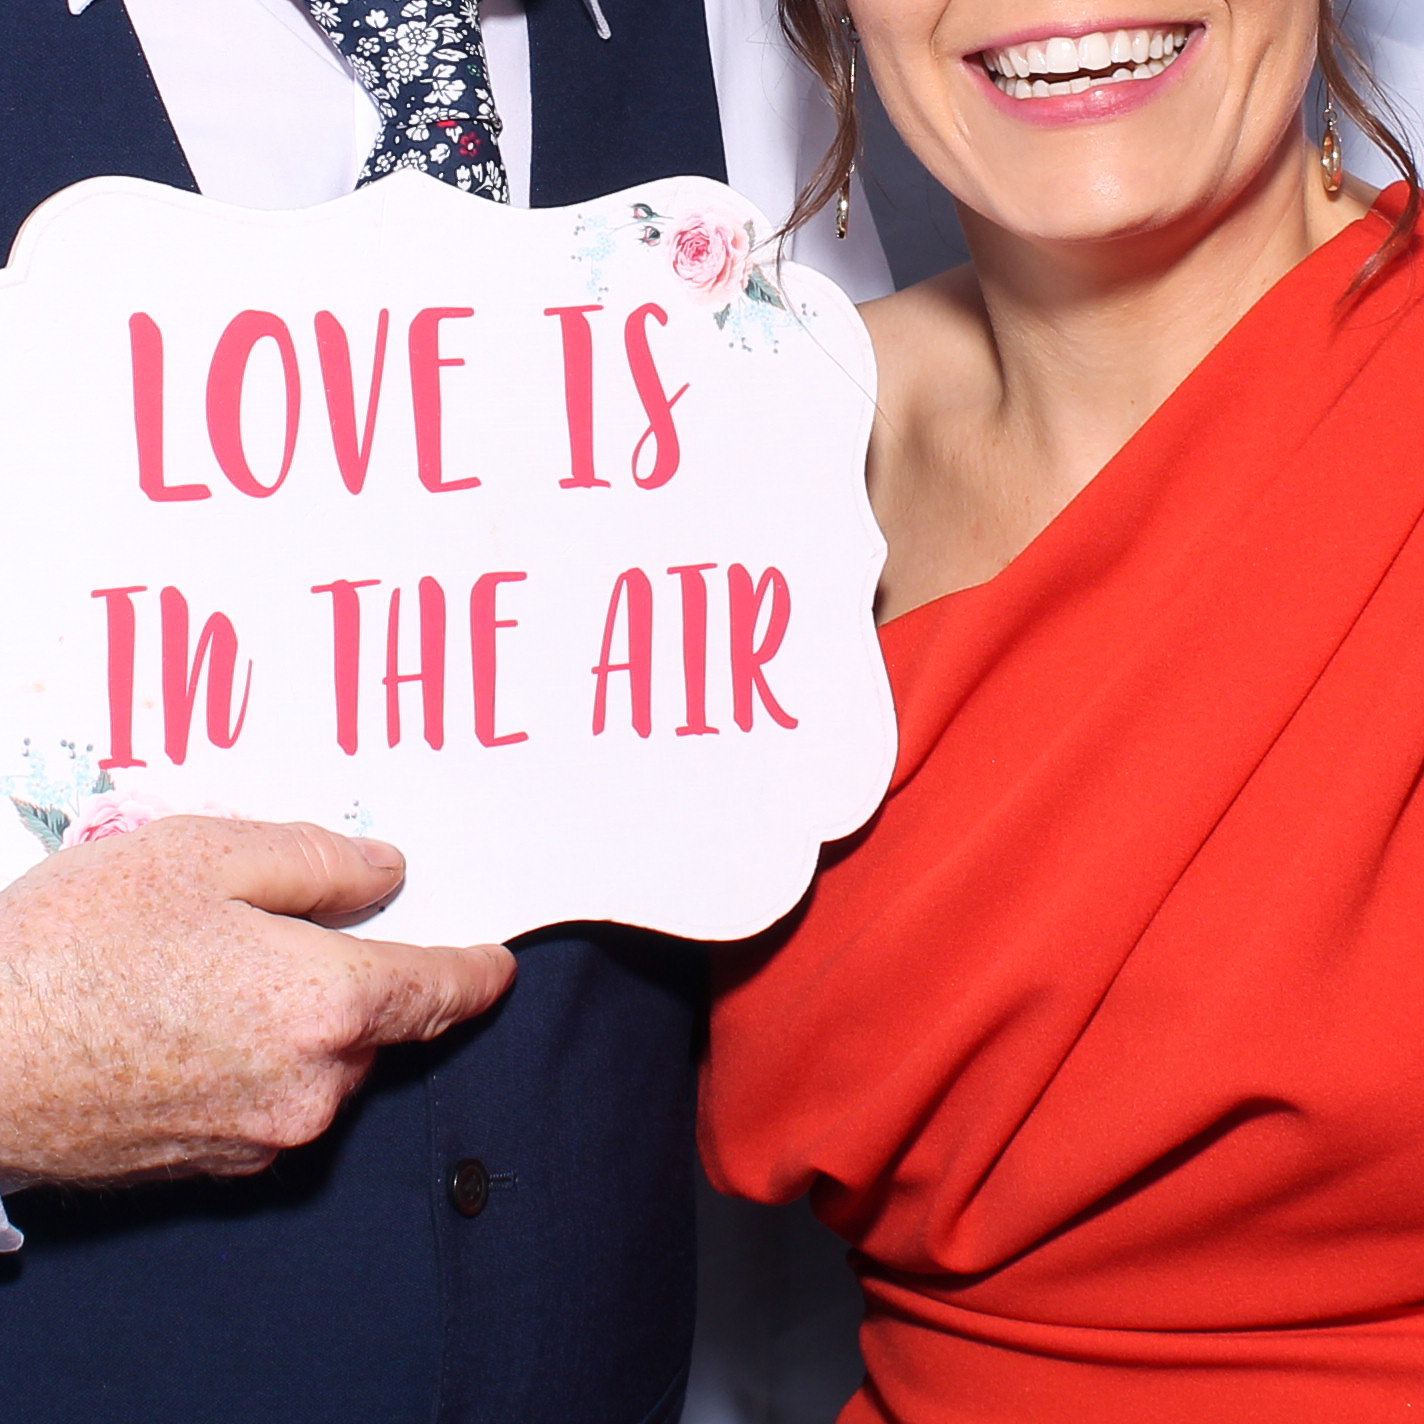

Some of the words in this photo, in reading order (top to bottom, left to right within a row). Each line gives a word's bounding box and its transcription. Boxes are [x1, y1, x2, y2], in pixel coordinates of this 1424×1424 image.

[130, 307, 483, 502] LOVE
[543, 302, 691, 490] IS
[310, 570, 529, 756] THE
[591, 562, 800, 738] AIR
